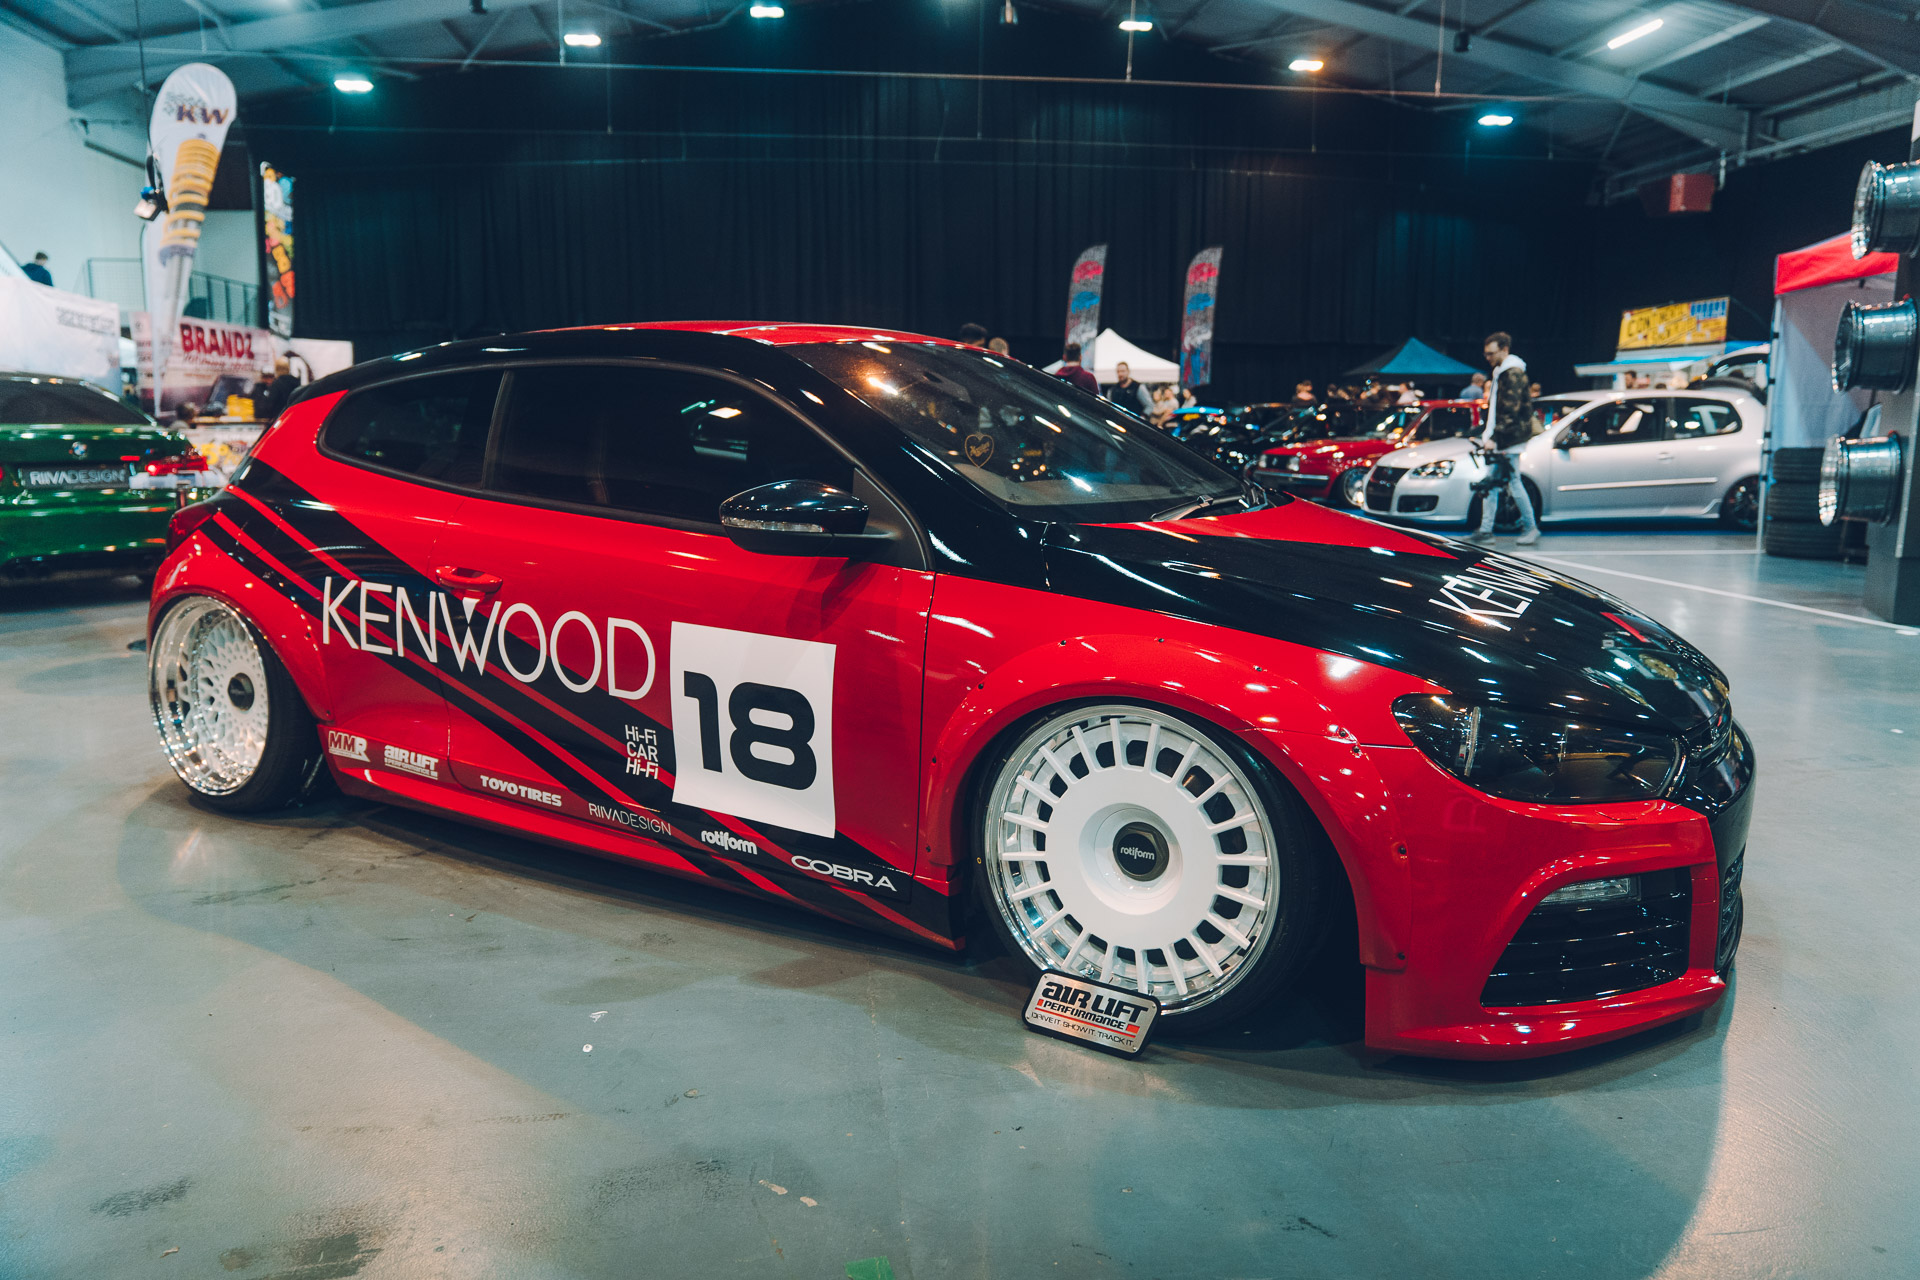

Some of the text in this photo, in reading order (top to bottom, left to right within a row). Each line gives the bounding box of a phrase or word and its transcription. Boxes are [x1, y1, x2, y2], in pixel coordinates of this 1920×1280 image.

[176, 105, 229, 125] KW
[322, 576, 656, 700] KENWOOD
[624, 724, 658, 746] Hi-Fi
[683, 670, 817, 791] 18
[328, 730, 370, 762] MMR
[626, 741, 659, 763] CAR
[625, 757, 659, 780] Hi-Fi
[479, 775, 563, 807] TOYO TIRES
[588, 802, 672, 836] RIIVADESIGN
[700, 829, 758, 855] rotiform
[1120, 846, 1155, 861] rotiform
[790, 854, 898, 892] COBRA
[1091, 994, 1149, 1023] LIFT
[1031, 1011, 1054, 1024] DRIVE
[1062, 1020, 1089, 1034] SHOW
[1097, 1030, 1125, 1045] TRACK
